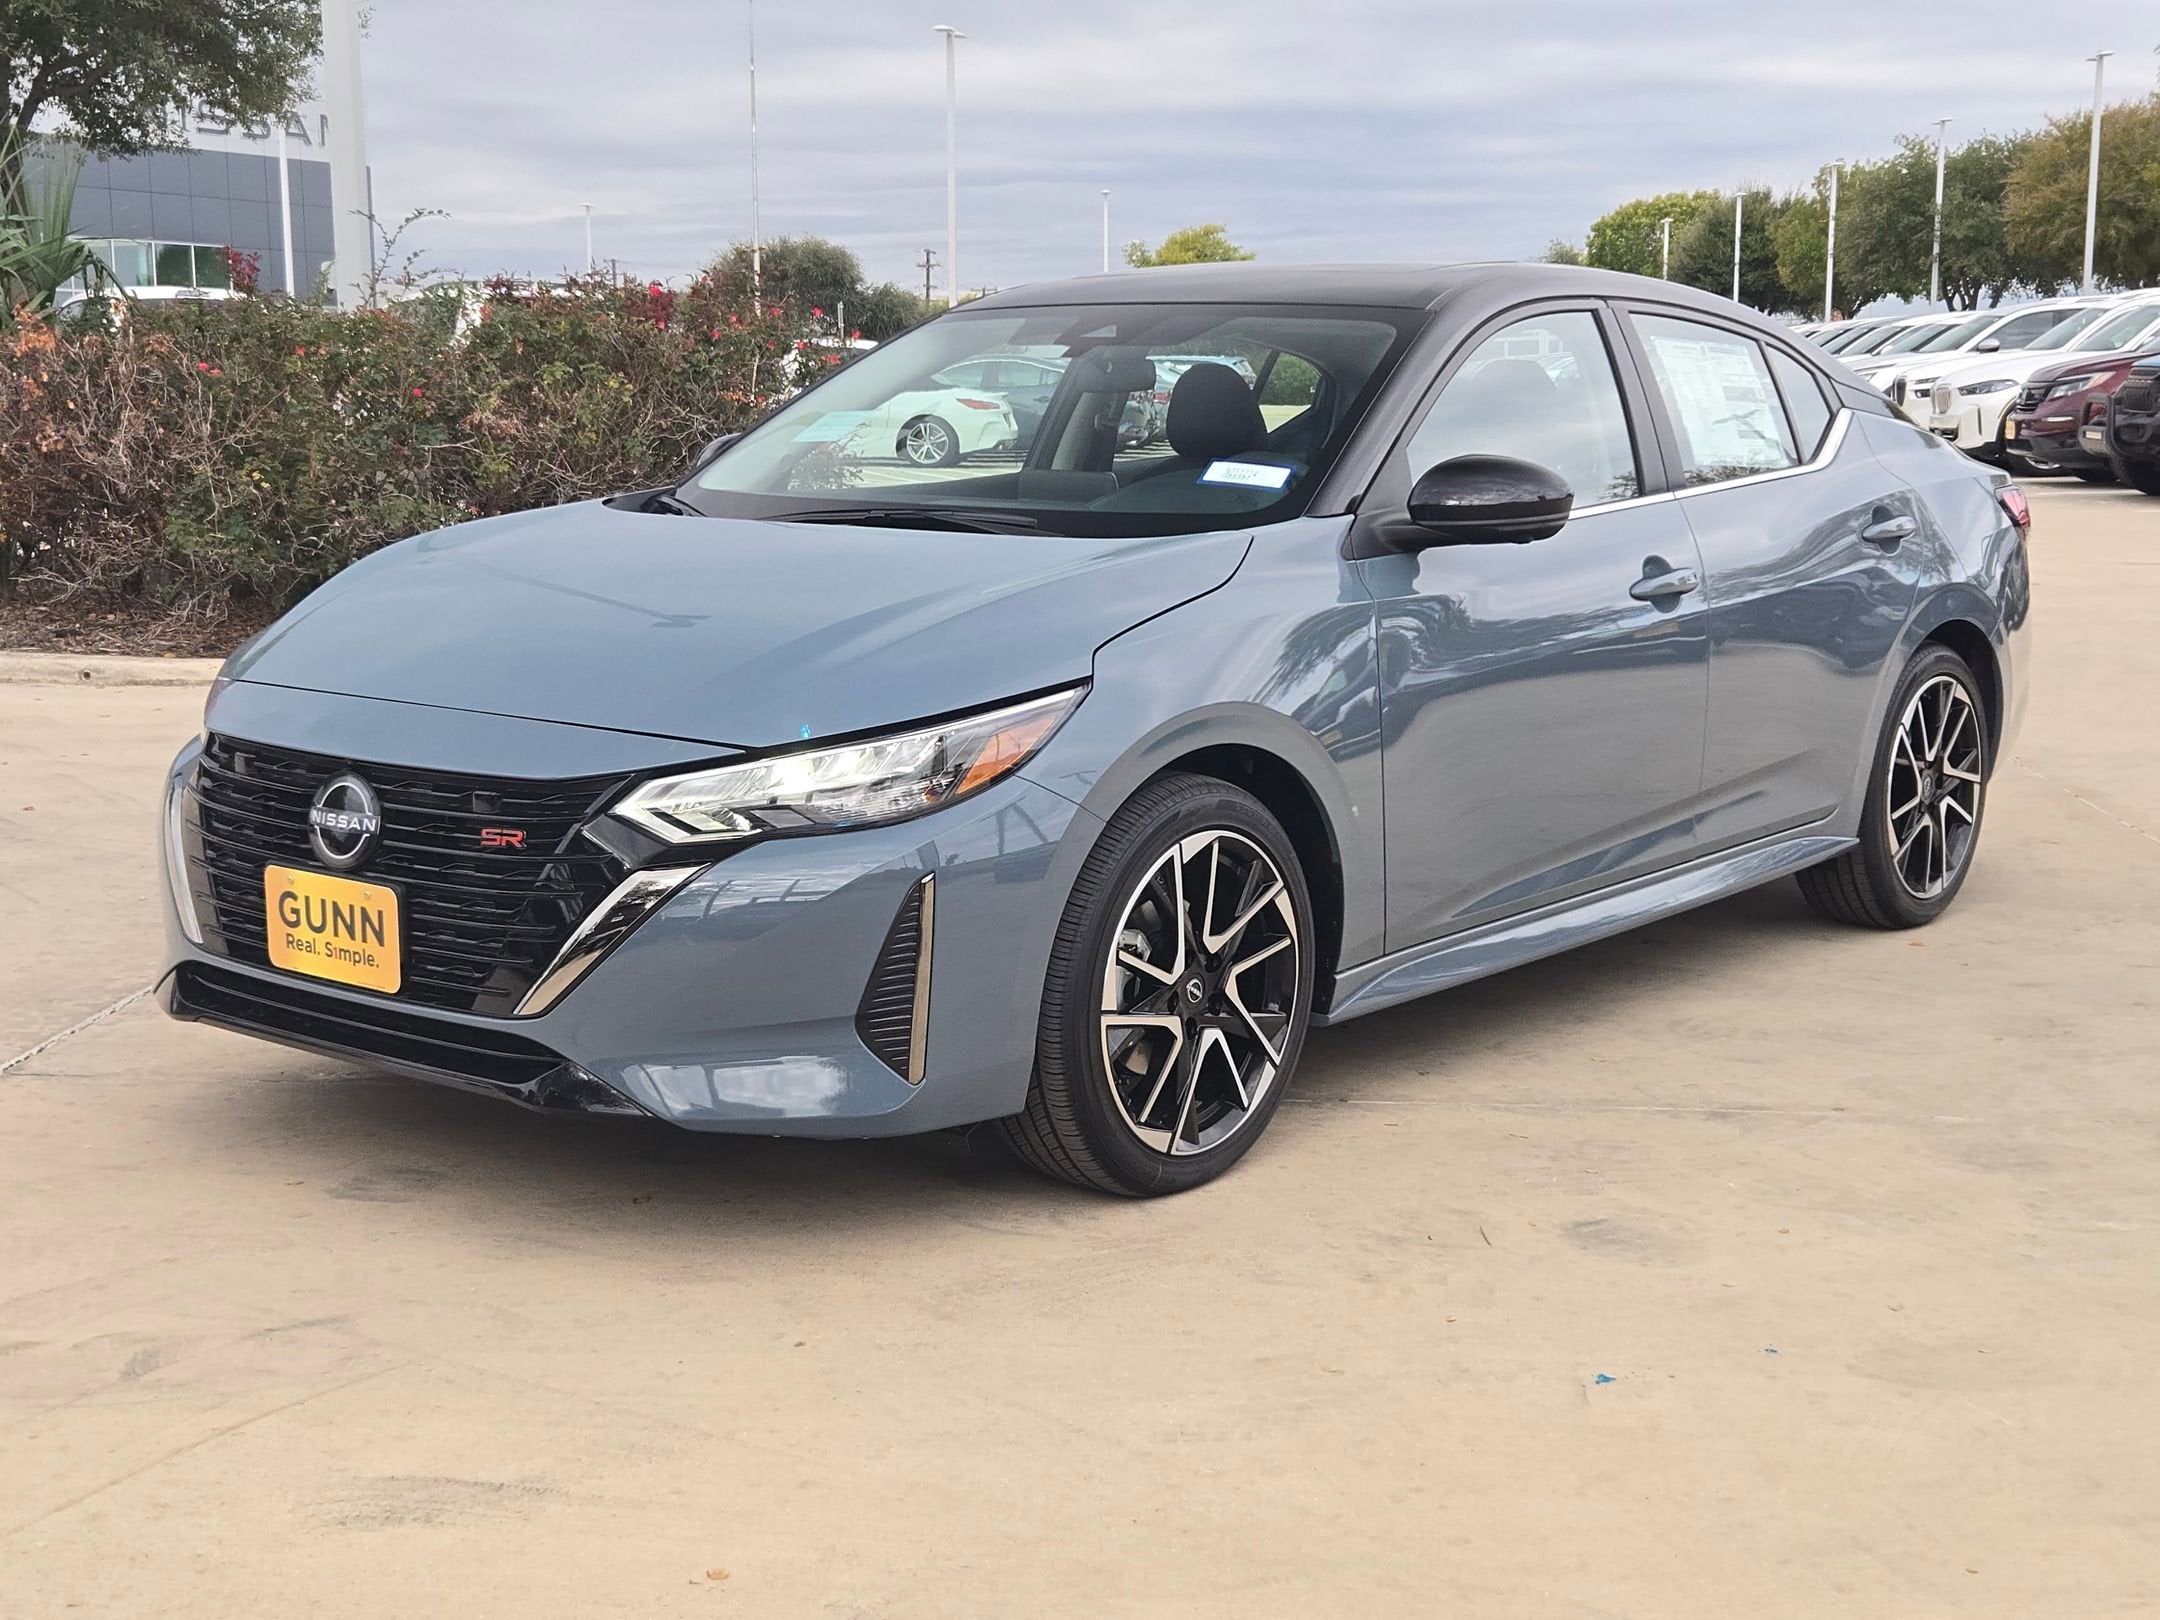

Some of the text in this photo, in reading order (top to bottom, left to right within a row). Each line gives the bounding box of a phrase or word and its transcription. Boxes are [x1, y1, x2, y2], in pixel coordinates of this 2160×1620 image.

[311, 809, 377, 832] NISSAN
[480, 827, 527, 848] SR
[278, 890, 385, 947] GUNN
[285, 932, 321, 955] Real.
